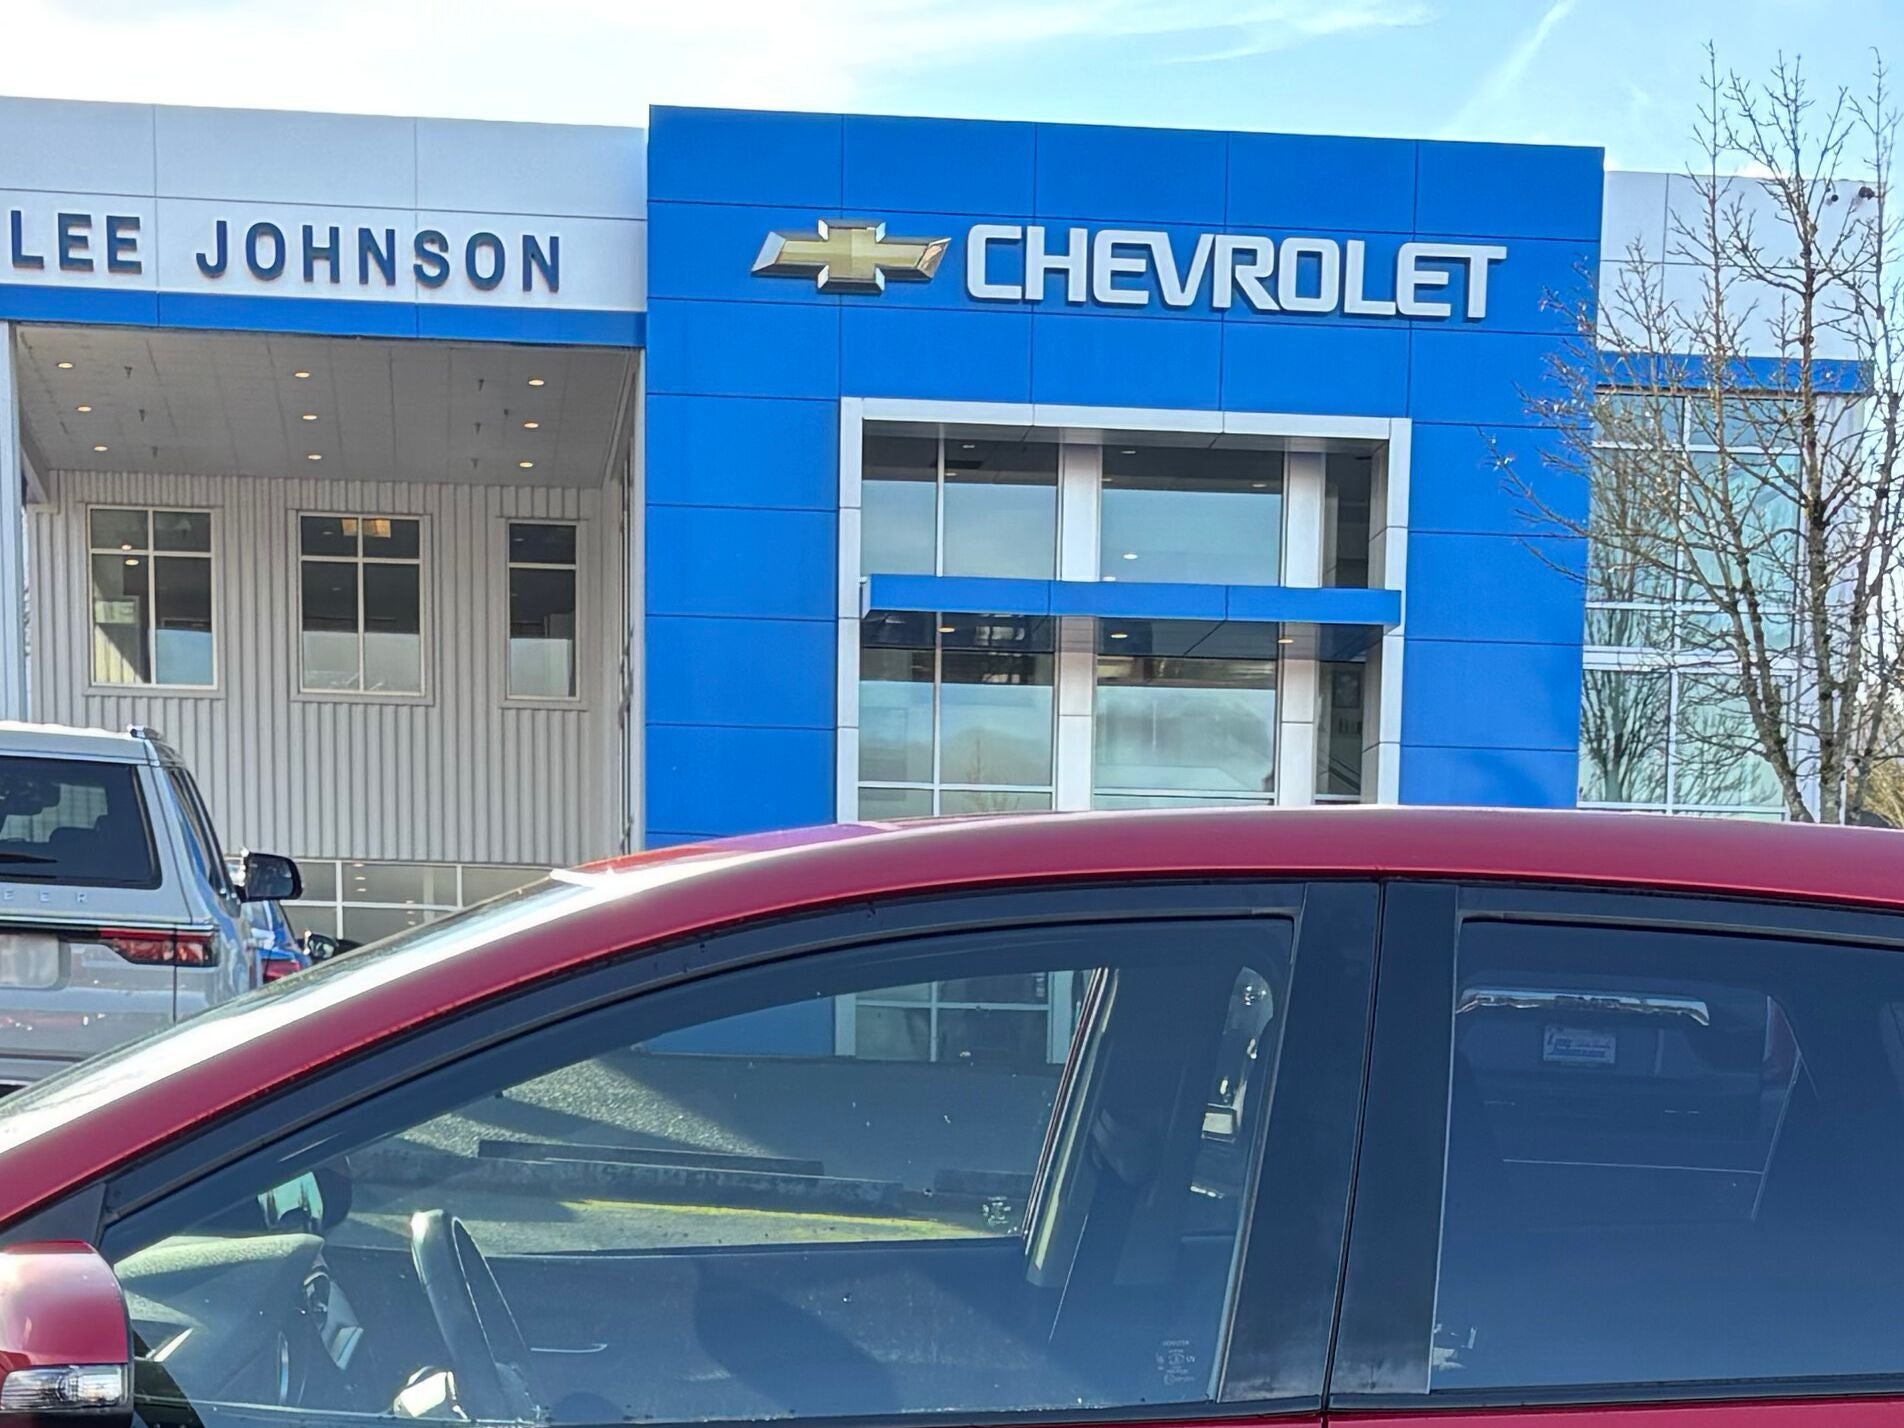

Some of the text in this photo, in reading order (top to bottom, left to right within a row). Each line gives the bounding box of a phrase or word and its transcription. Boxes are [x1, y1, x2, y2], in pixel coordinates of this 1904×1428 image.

[10, 209, 560, 293] LEE JOHNSON
[966, 224, 1508, 319] CHEVROLET
